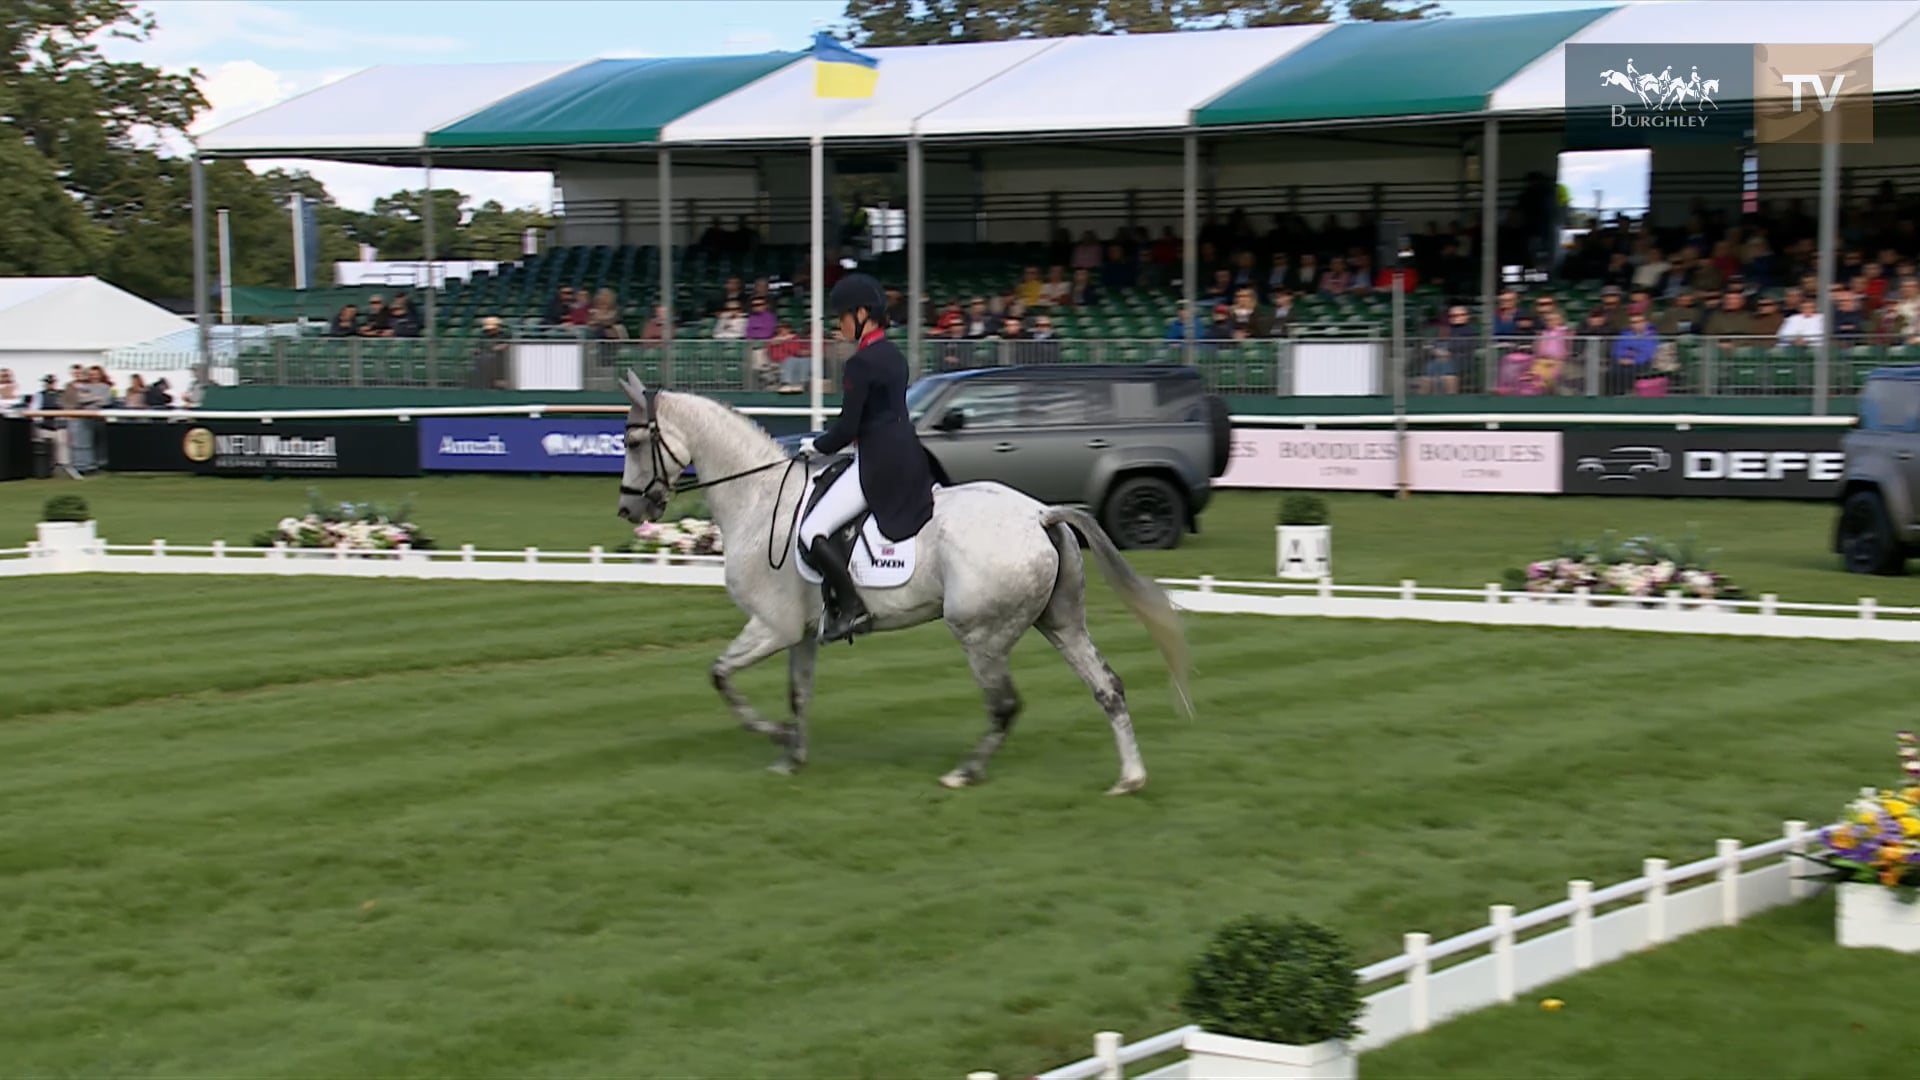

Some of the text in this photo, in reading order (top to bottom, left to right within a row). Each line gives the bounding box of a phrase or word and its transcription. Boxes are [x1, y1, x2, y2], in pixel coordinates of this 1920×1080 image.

[216, 435, 337, 456] NFU Mutual
[1278, 441, 1398, 460] BOODLES
[1419, 443, 1545, 462] BOODLES
